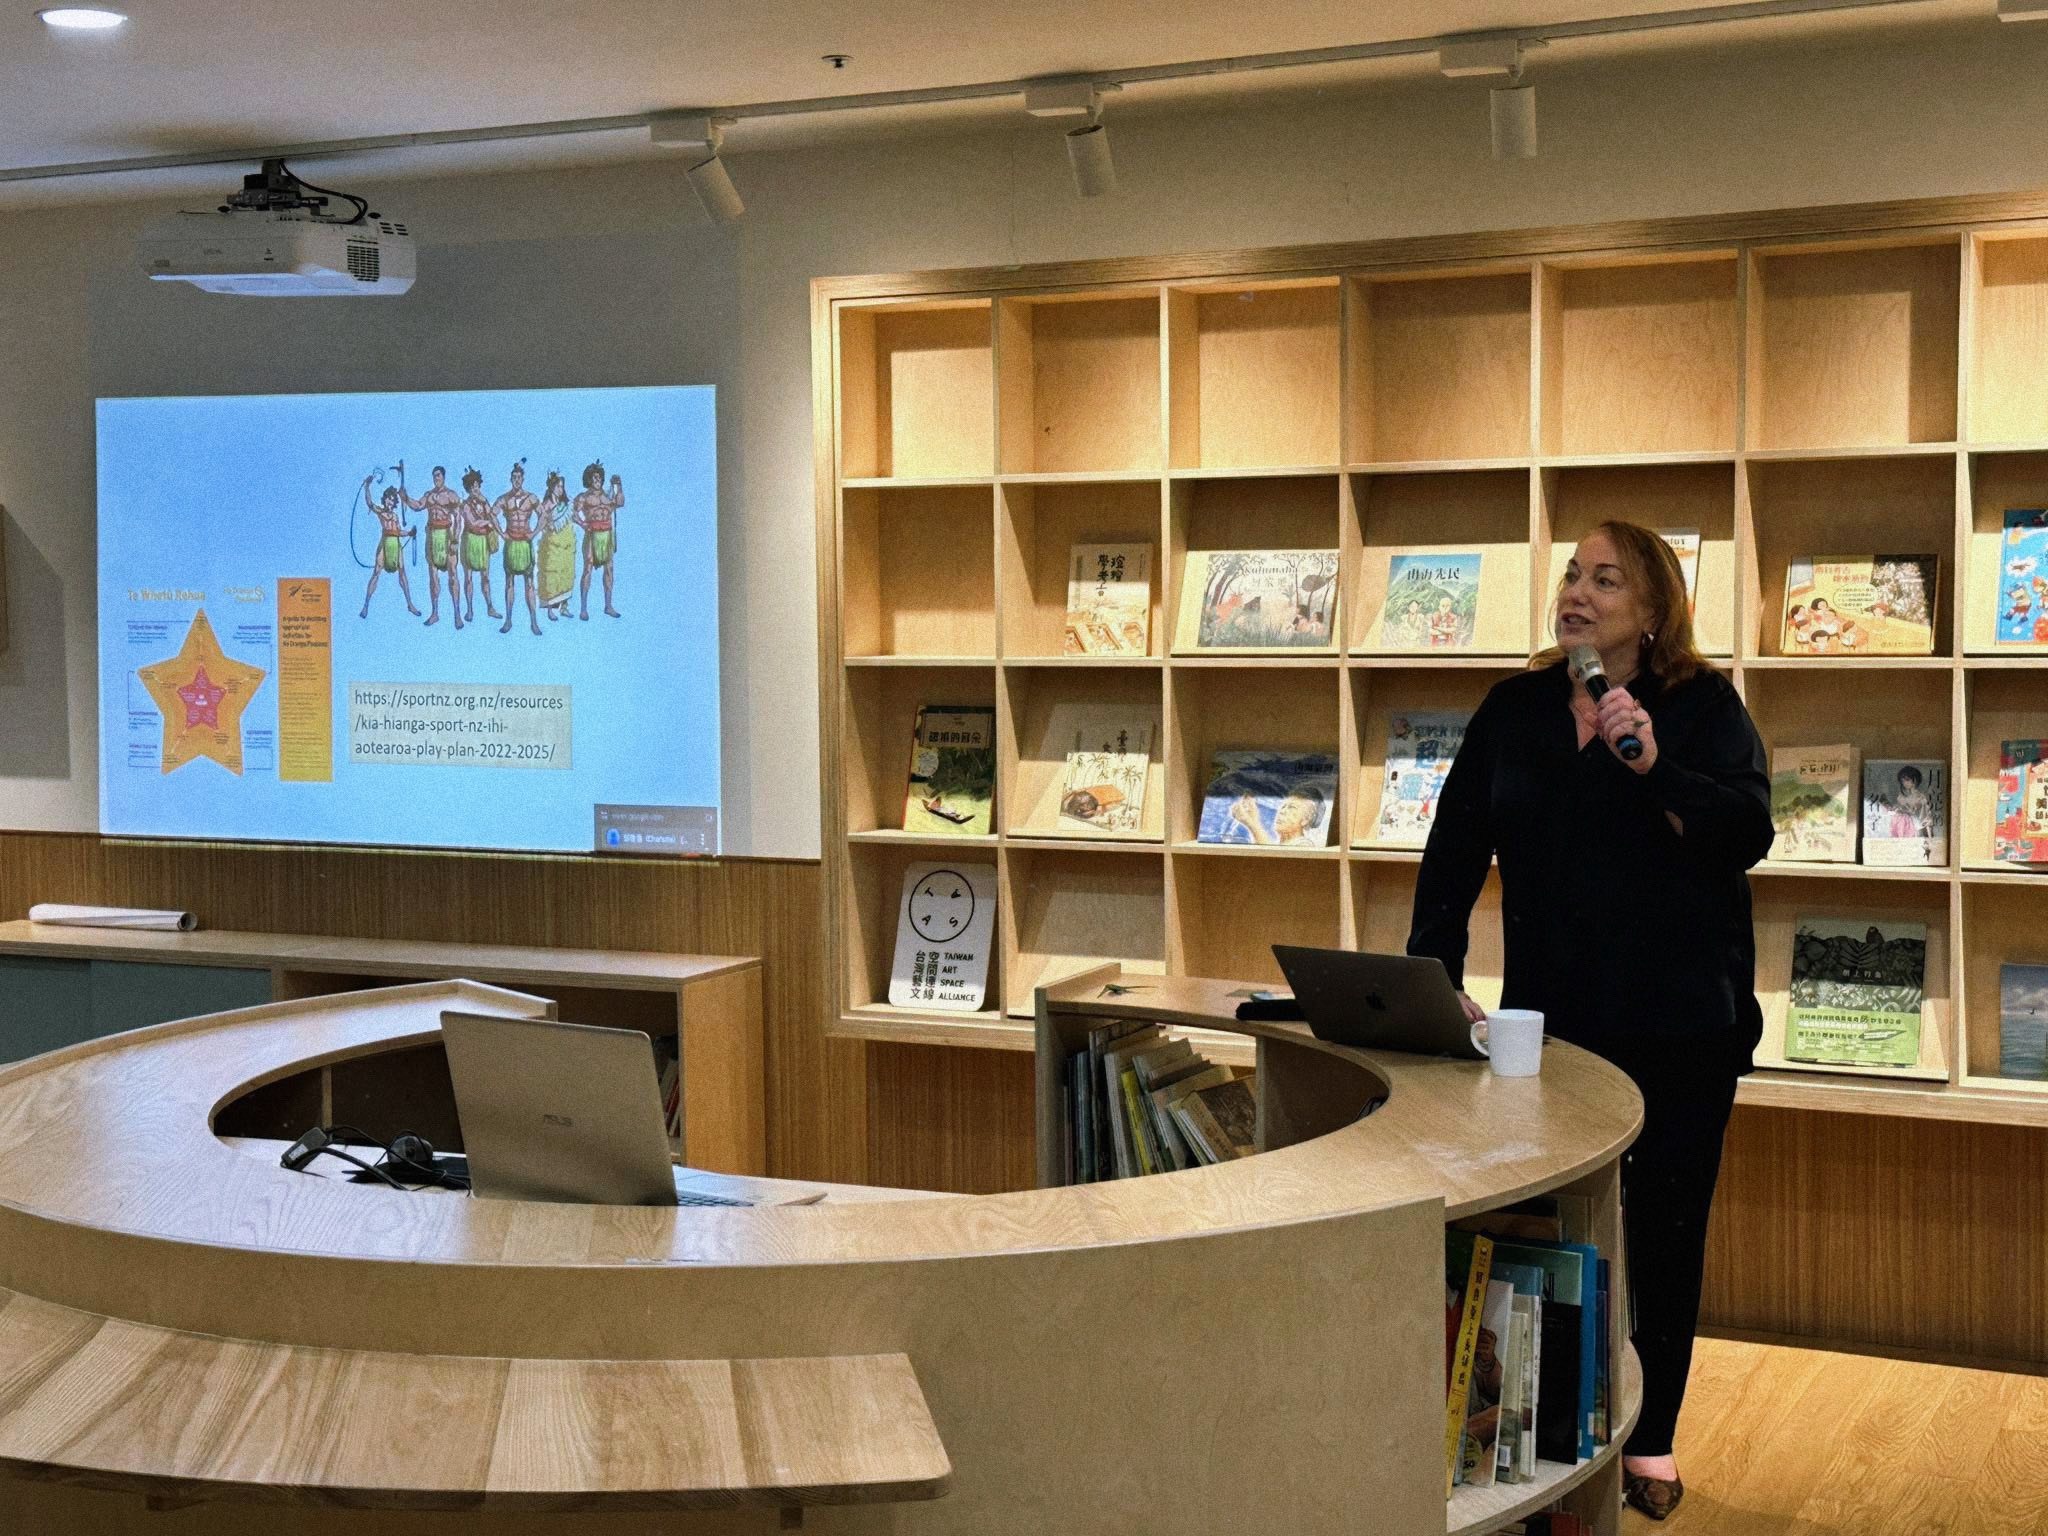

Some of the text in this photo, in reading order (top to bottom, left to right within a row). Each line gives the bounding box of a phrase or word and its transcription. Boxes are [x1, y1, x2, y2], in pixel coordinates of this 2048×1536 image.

[354, 689, 564, 711] https://sportnz.org.nz/resources
[354, 713, 509, 735] /kia-hianga-sport-nz-ihi-
[354, 740, 556, 762] aotearoa-play-plan-2022-2025/
[943, 951, 974, 961] TAIWAN
[941, 966, 958, 974] ART
[939, 979, 965, 988] SPACE
[937, 991, 976, 1002] ALLIANCE
